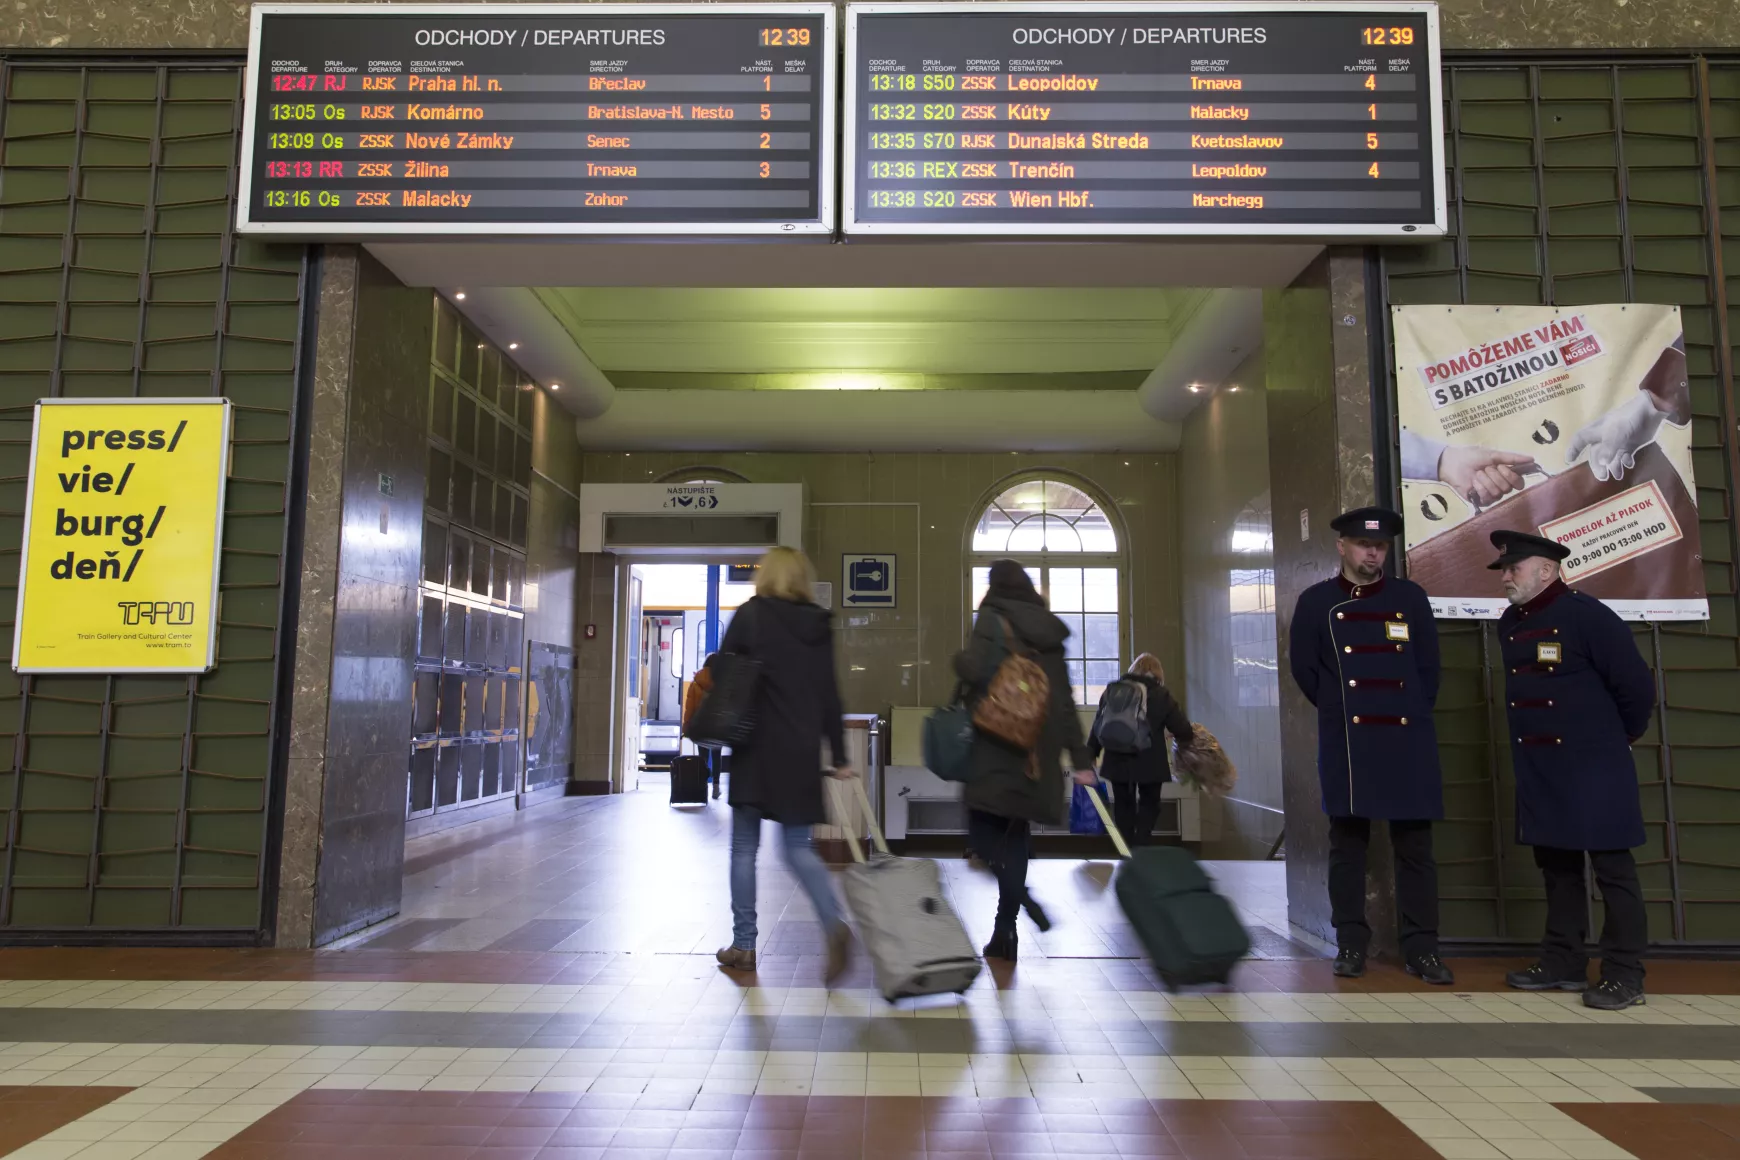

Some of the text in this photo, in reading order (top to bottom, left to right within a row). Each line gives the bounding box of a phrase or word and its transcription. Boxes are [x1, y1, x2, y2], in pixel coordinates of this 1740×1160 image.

[415, 30, 666, 47] ODCHODY / DEPARTURES
[1012, 28, 1267, 46] ODCHODY / DEPARTURES
[273, 75, 771, 91] 12:47 RJ RJSK Praha hl. n. Břeclav 1
[871, 75, 1376, 91] 13:18 S50 ZSSK Leopoldov Trnava 4
[272, 104, 771, 120] 13:05 Os RJSK Komárno Bratislava-N. Mesto 5
[871, 104, 1376, 120] 13:32 S20 ZSSK Kúty Malacky 1
[270, 133, 770, 150] 13:09 Os ZSSK Nové Zámky Senec 2
[871, 133, 1378, 150] 13:35 S70 RJSK Dunajská Streda Kvetoslavov 5
[267, 160, 770, 178] 13:13 RR ZSSK Žilina Trnava 3
[871, 162, 1379, 178] 13:36 REX ZSSK Trenčín Leopoldov 4
[266, 191, 628, 208] 13:16 Os ZSSK Malacky Zohor
[871, 191, 1263, 208] 13:38 S20 ZSSK Wien Hbf. Marchegg
[1424, 316, 1585, 383] POMÔŽEME VÁM
[1435, 350, 1558, 405] S BATOŽINOU
[1440, 409, 1469, 423] NECHAJTE
[1540, 374, 1570, 388] ZADARMO
[1528, 390, 1546, 400] NOTA
[61, 420, 188, 458] press/
[58, 463, 135, 495] vie/
[55, 506, 166, 546] burg/
[1557, 499, 1653, 544] PONDELOK AŽ PIATOK
[1600, 525, 1627, 541] PRACOVNÝ
[1566, 522, 1666, 569] OD 9:00 DO 13:00 HOD
[50, 549, 144, 582] deň/
[118, 602, 194, 625] TRAM
